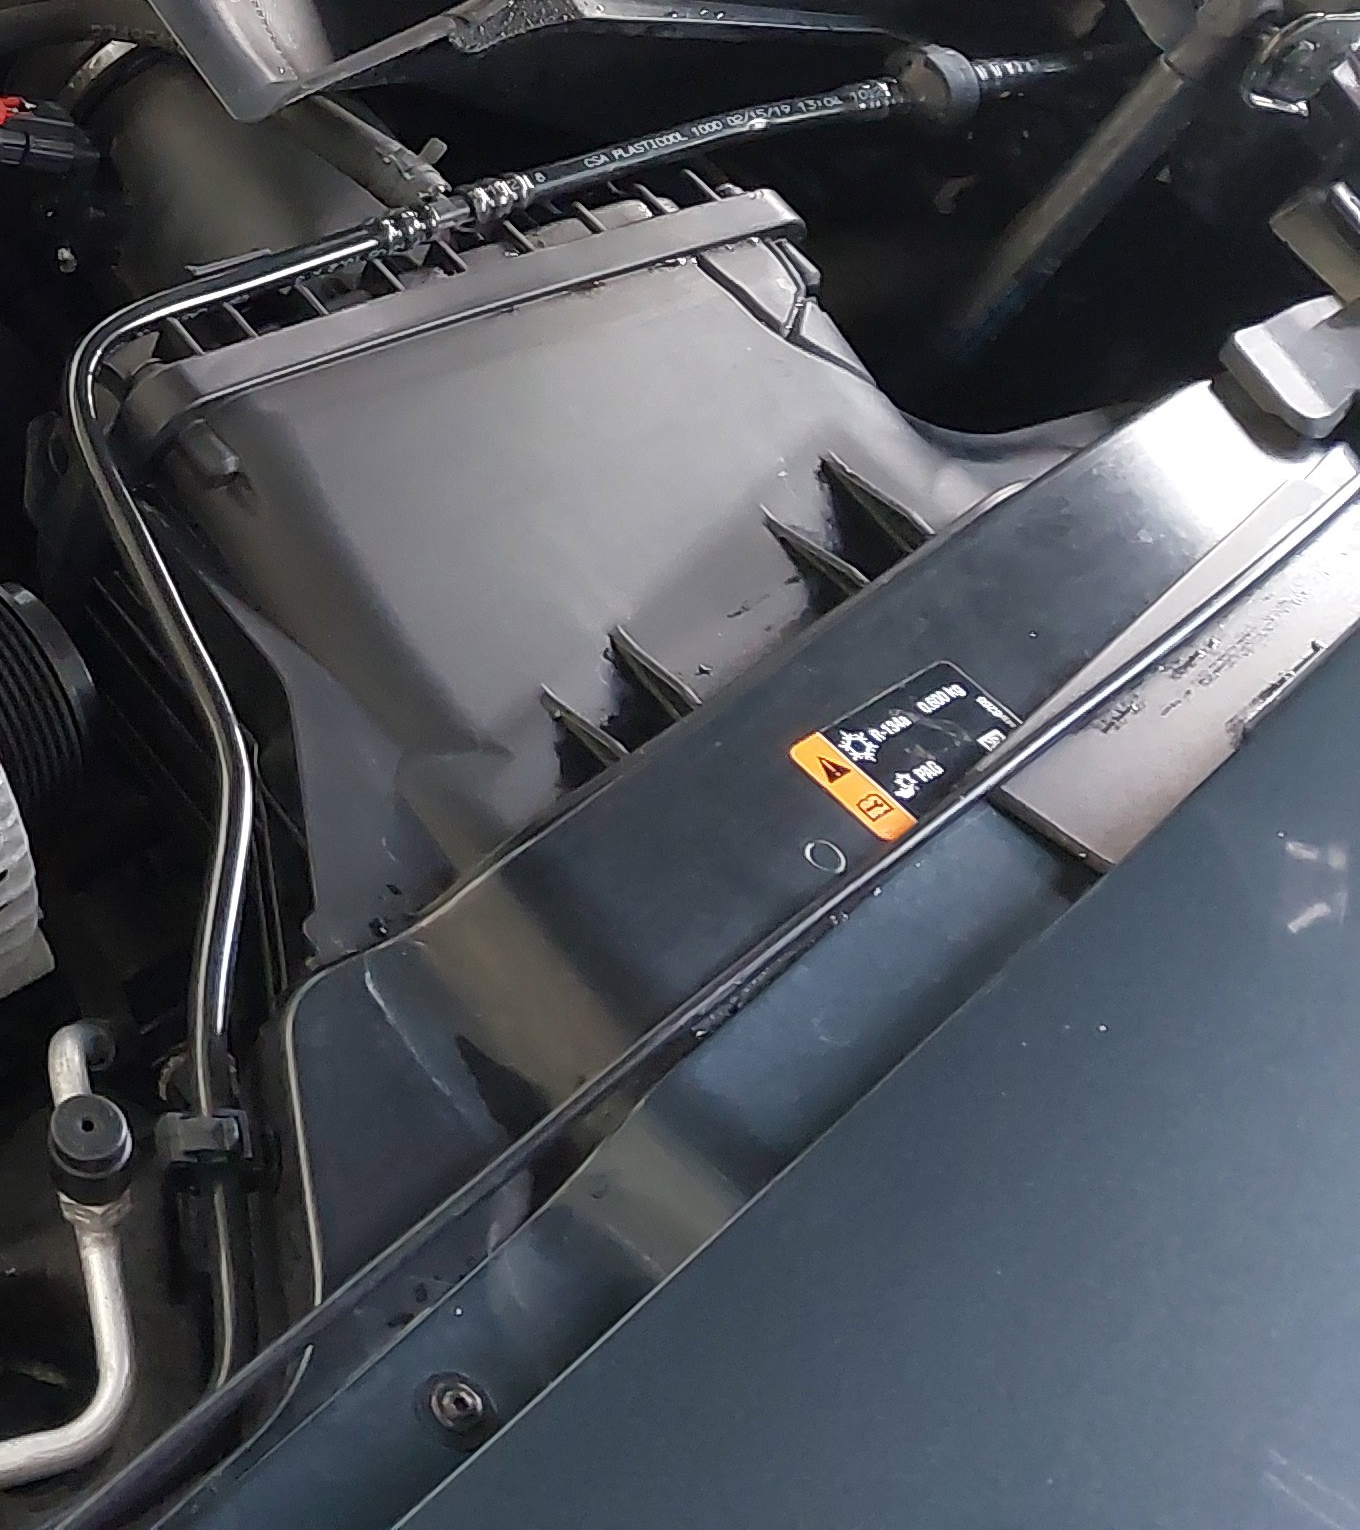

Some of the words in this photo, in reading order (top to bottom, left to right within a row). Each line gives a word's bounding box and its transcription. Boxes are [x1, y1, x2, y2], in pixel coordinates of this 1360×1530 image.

[583, 154, 610, 167] CSA
[611, 131, 688, 160] PLASTICOOL
[691, 120, 723, 136] 1000
[912, 761, 944, 782] PAG
